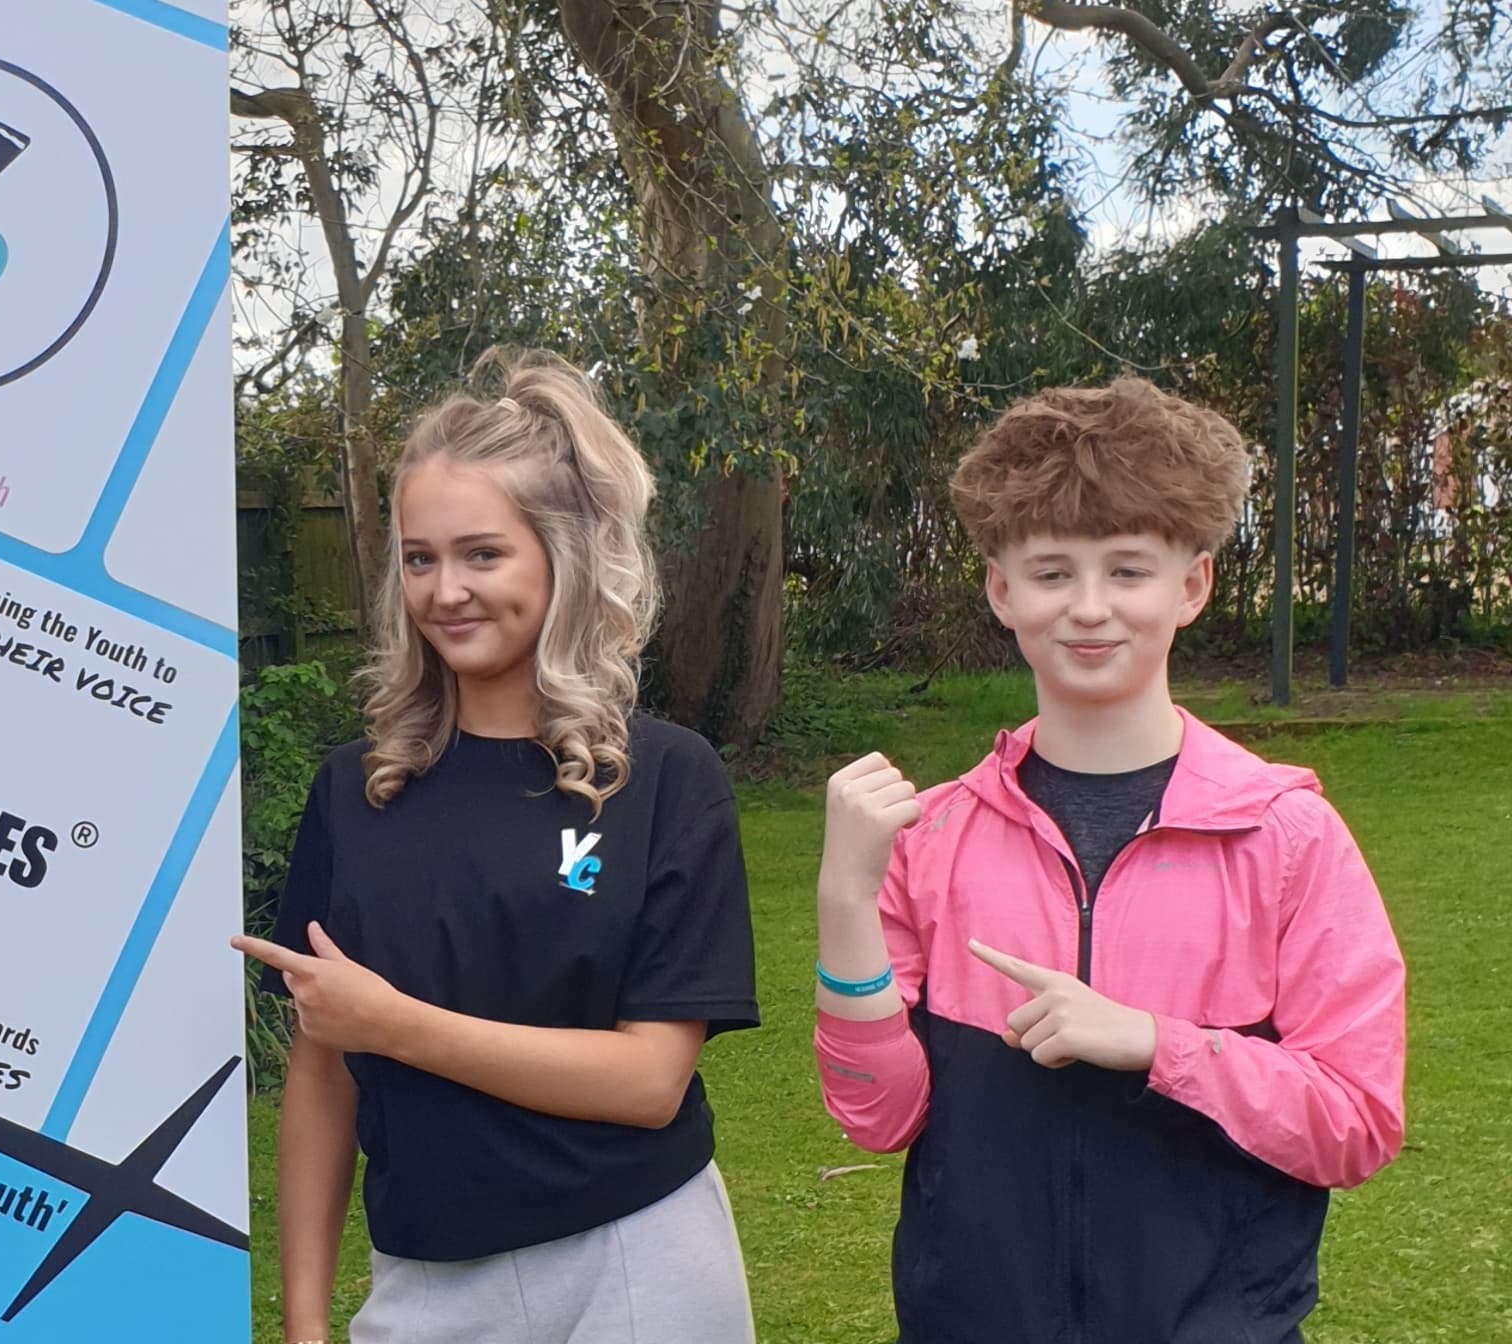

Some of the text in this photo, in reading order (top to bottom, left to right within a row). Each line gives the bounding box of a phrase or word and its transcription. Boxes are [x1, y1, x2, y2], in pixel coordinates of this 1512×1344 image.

[41, 609, 78, 643] the
[84, 625, 149, 672] Youth
[155, 657, 177, 684] to
[76, 667, 173, 725] VOICE
